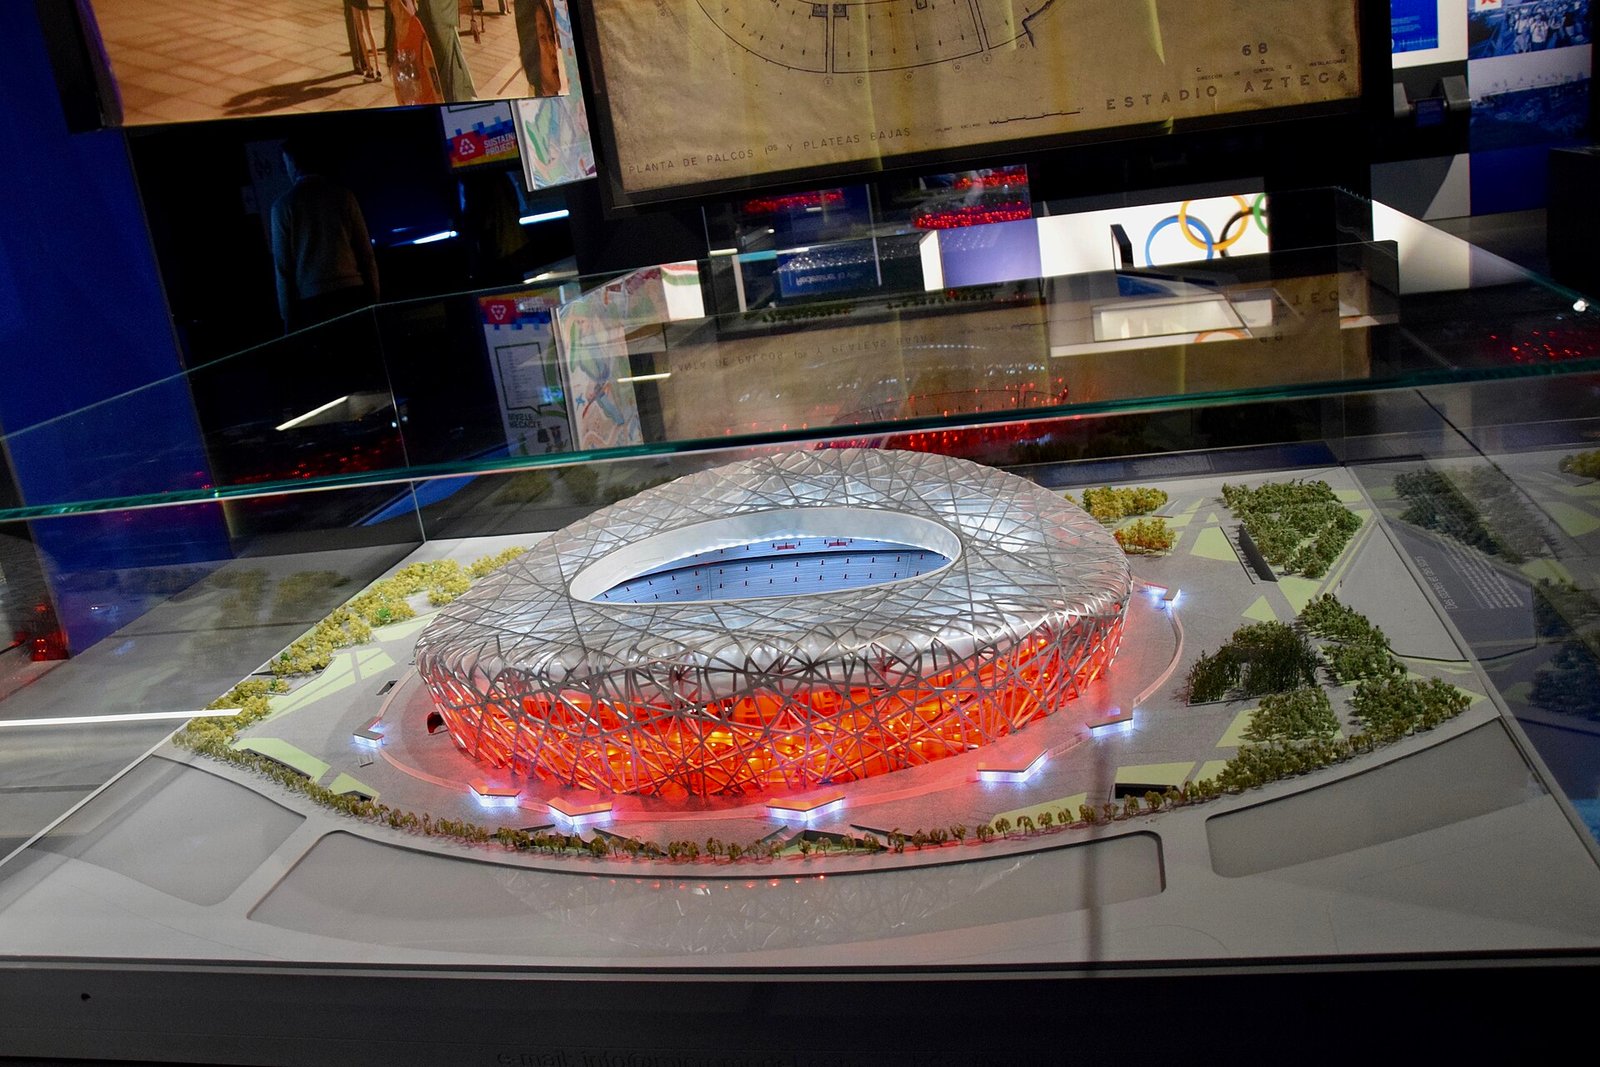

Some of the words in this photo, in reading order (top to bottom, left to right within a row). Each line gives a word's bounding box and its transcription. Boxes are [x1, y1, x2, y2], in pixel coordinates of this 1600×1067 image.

[1242, 42, 1268, 56] 68
[1106, 85, 1217, 110] ESTADIO
[1244, 70, 1347, 93] AZTECA
[483, 132, 515, 148] SUSTAIN
[628, 160, 674, 175] PLANTA
[683, 156, 698, 167] DE
[706, 149, 754, 163] PALCOS
[787, 143, 793, 151] Y
[803, 134, 861, 150] PLATEAS
[870, 127, 911, 141] BAJAS
